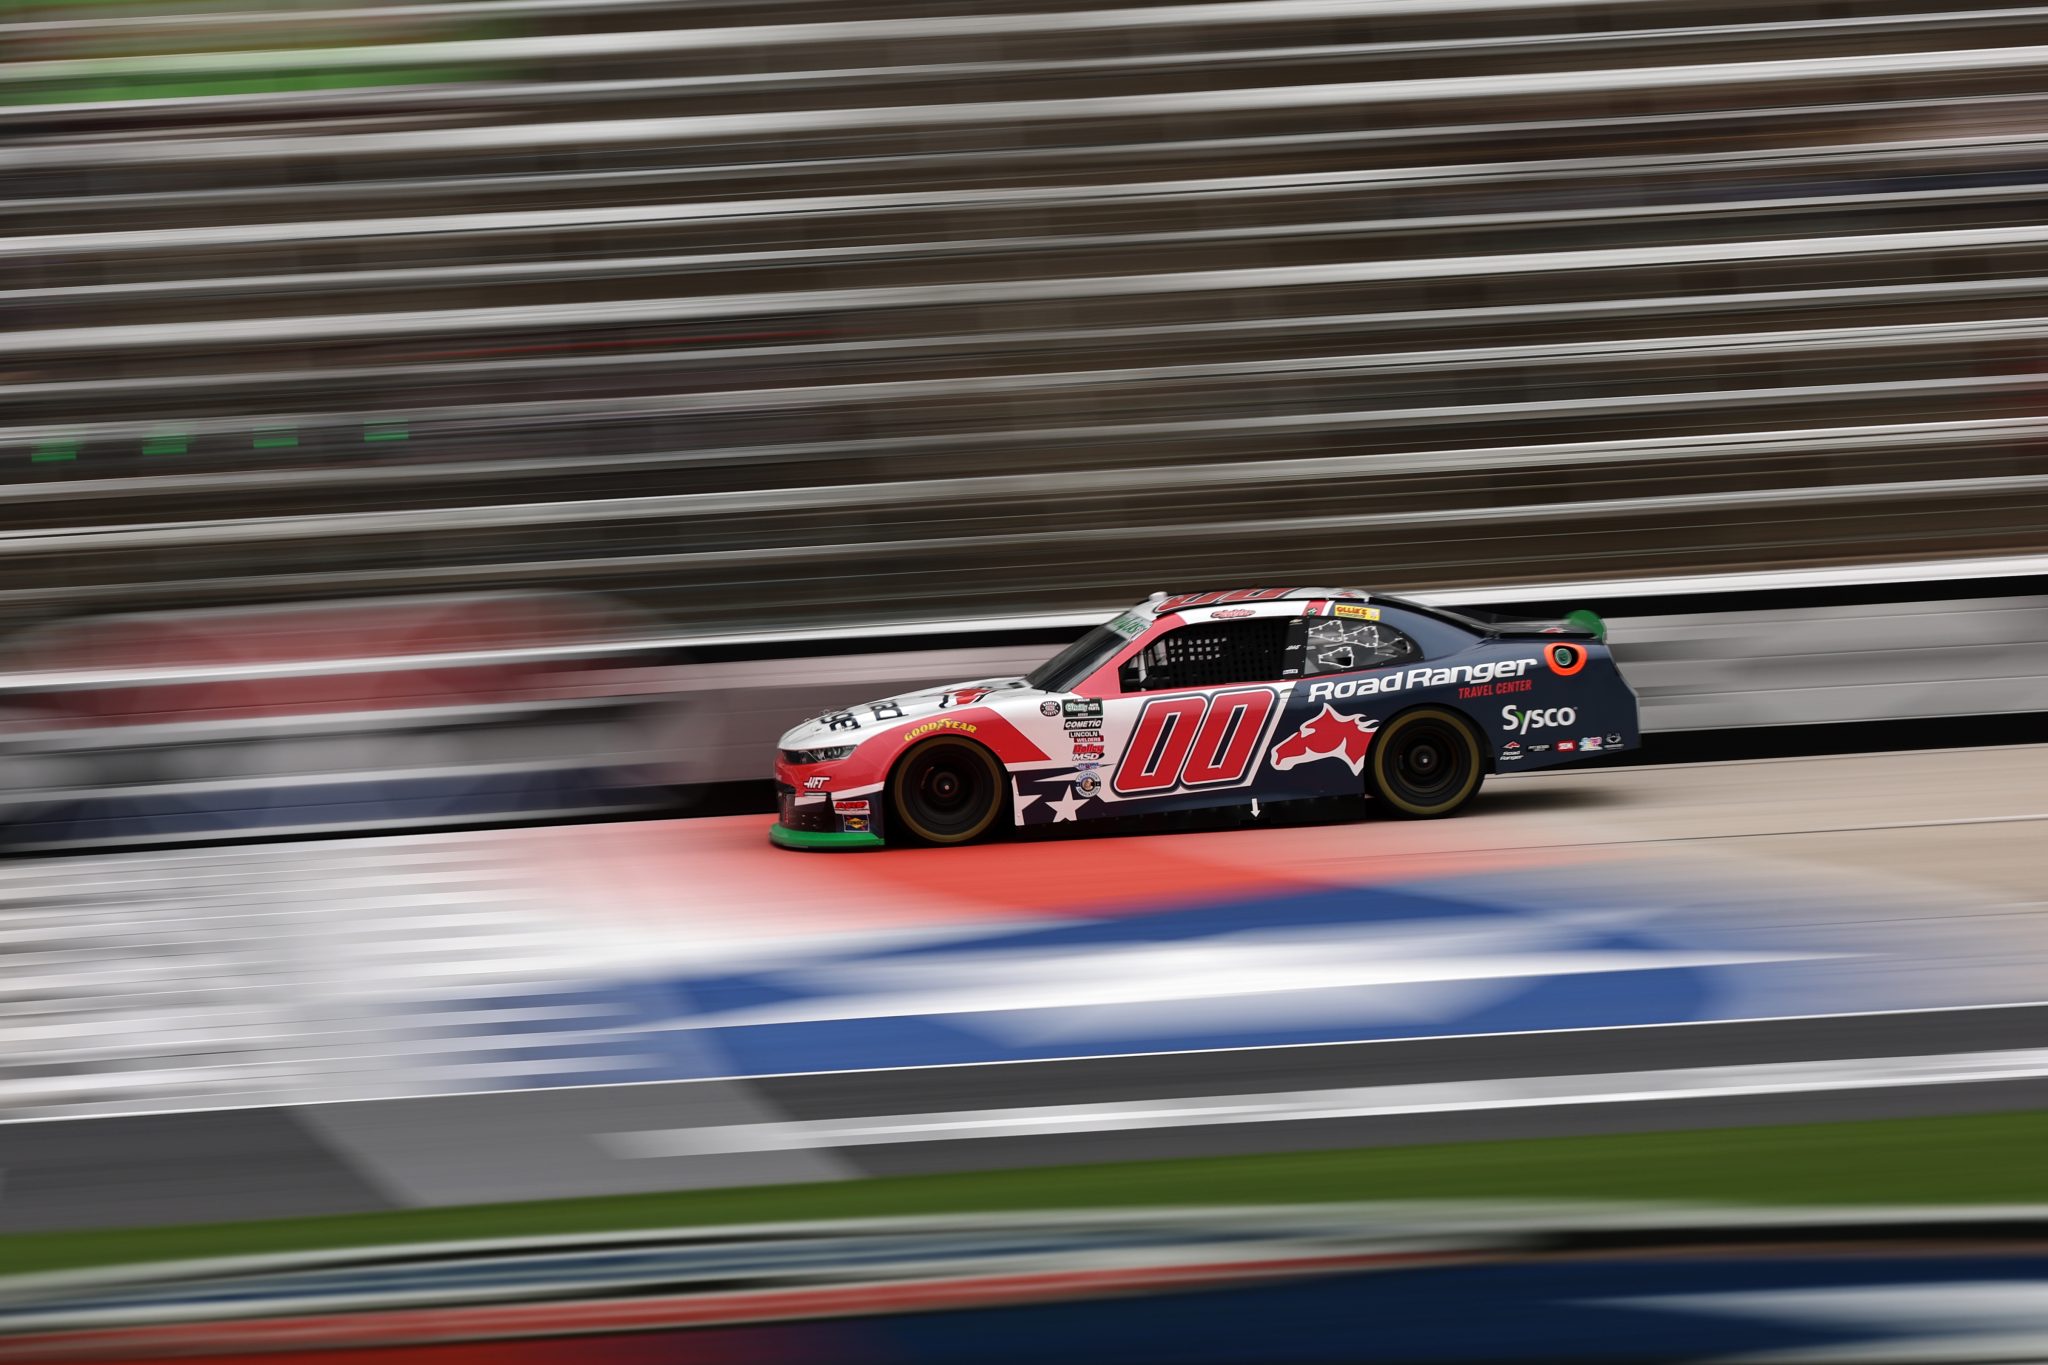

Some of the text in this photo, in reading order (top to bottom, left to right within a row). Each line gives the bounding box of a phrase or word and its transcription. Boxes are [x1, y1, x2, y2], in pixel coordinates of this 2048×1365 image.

[1307, 658, 1538, 703] Road Ranger
[1458, 679, 1532, 700] TRAVEL CENTER
[1065, 719, 1101, 728] COMETIC
[1501, 704, 1577, 735] Sysco
[1111, 687, 1279, 797] 00
[1072, 752, 1100, 761] MSD
